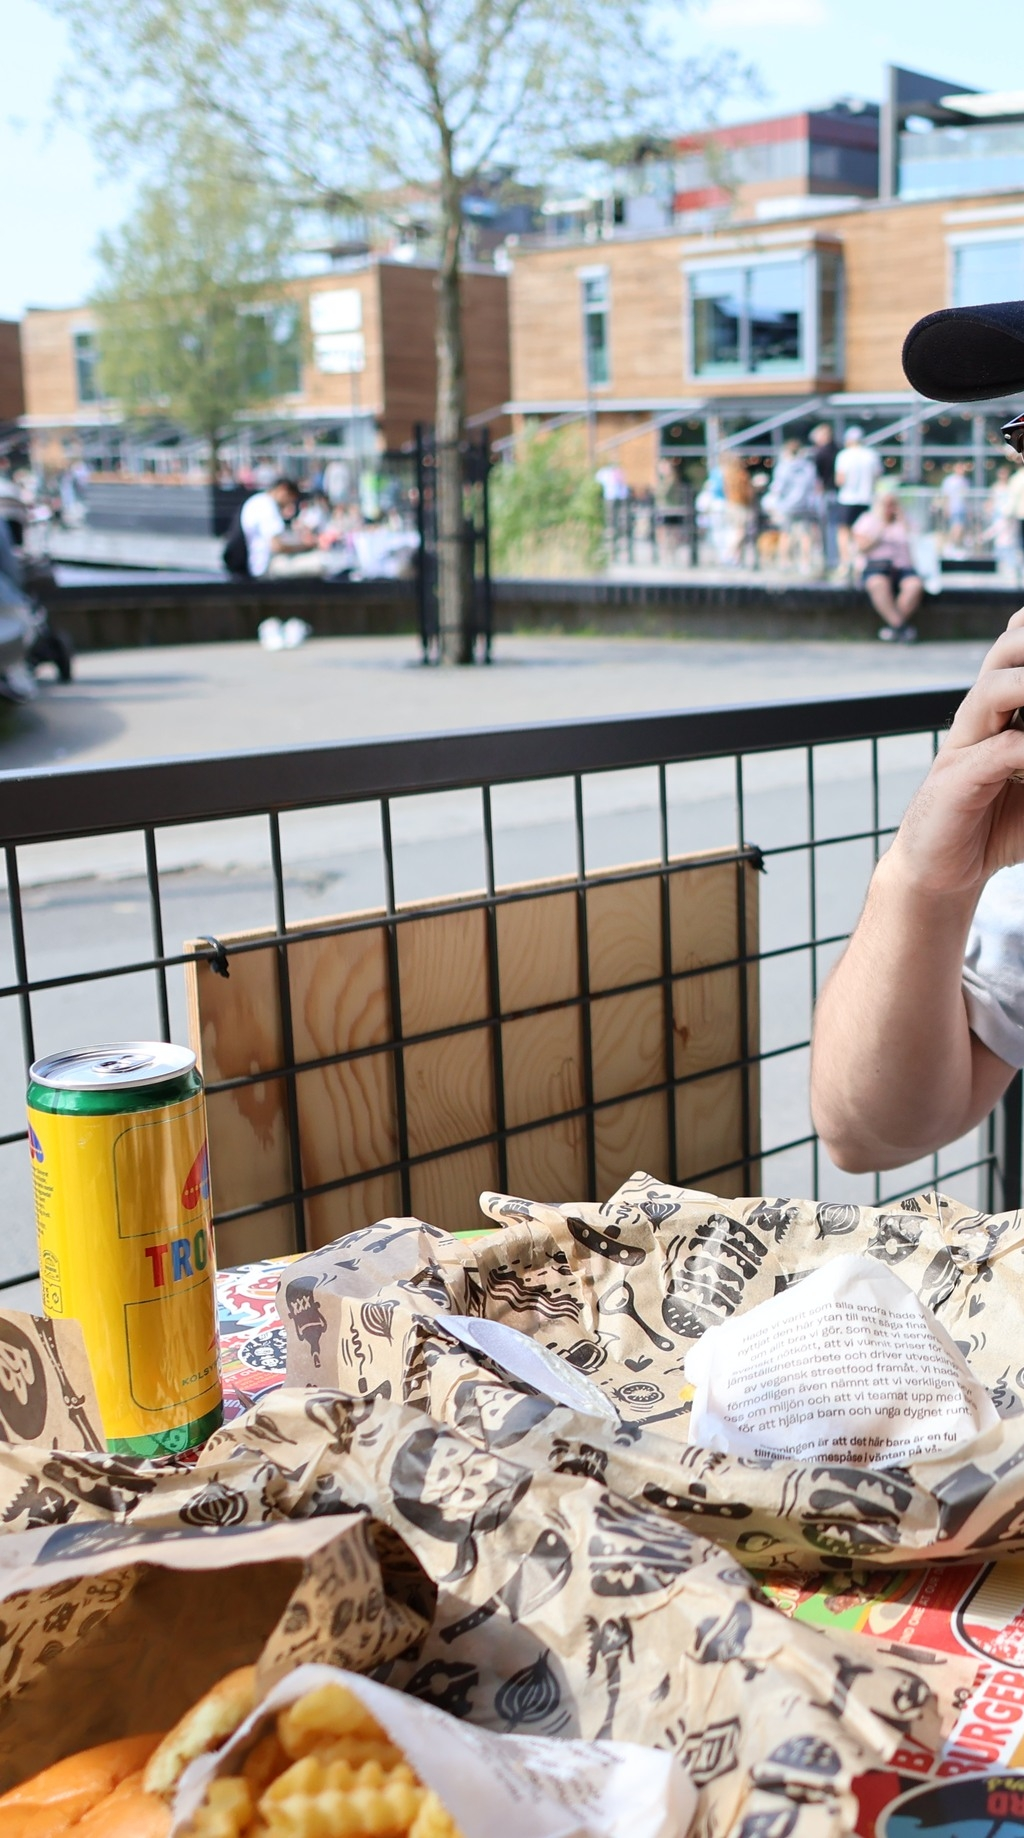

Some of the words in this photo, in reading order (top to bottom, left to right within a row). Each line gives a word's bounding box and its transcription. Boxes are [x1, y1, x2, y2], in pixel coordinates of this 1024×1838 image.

[145, 1230, 214, 1288] TRO
[771, 1321, 779, 1330] vi
[783, 1311, 806, 1325] varit
[809, 1302, 832, 1315] som
[835, 1302, 854, 1310] alla
[857, 1304, 887, 1316] andra
[889, 1310, 916, 1320] hade
[773, 1328, 793, 1340] den
[817, 1313, 842, 1325] ytan
[845, 1313, 858, 1321] till
[861, 1315, 877, 1324] att
[879, 1319, 903, 1330] säga
[906, 1321, 927, 1329] fina
[750, 1350, 767, 1362] om
[788, 1335, 806, 1345] bra
[809, 1328, 818, 1338] vi
[821, 1326, 842, 1338] gör.
[846, 1326, 871, 1335] Som
[873, 1329, 888, 1338] att
[824, 1340, 840, 1349] att
[844, 1339, 854, 1347] vi
[857, 1339, 891, 1348] vunnit
[894, 1341, 925, 1350] priser
[844, 1351, 867, 1360] och
[870, 1349, 902, 1360] driver
[744, 1384, 757, 1394] av
[760, 1370, 808, 1388] vegansk
[811, 1363, 873, 1377] streetfood
[876, 1362, 918, 1373] framåt.
[920, 1365, 931, 1374] Vi
[934, 1366, 960, 1378] hade
[723, 1413, 744, 1423] oss
[747, 1407, 766, 1419] om
[769, 1399, 804, 1414] miljön
[807, 1394, 831, 1406] och
[834, 1393, 851, 1403] att
[854, 1391, 864, 1399] vi
[867, 1391, 908, 1400] teamat
[911, 1392, 933, 1403] upp
[936, 1392, 962, 1402] med
[727, 1387, 795, 1412] förmodligen
[799, 1381, 827, 1393] även
[831, 1378, 869, 1389] nämnt
[872, 1378, 889, 1387] att
[893, 1377, 902, 1385] vi
[904, 1377, 955, 1389] verkligen
[738, 1422, 755, 1433] för
[758, 1420, 776, 1432] att
[778, 1412, 814, 1429] hjälpa
[817, 1408, 846, 1419] barn
[849, 1405, 872, 1416] och
[874, 1407, 901, 1419] unga
[903, 1405, 942, 1420] dygnet
[946, 1406, 973, 1417] runt.
[817, 1436, 829, 1446] är
[832, 1436, 848, 1445] att
[850, 1435, 867, 1446] det
[868, 1436, 885, 1447] här
[886, 1436, 911, 1448] bara
[914, 1434, 923, 1443] är
[927, 1433, 941, 1441] en
[943, 1431, 957, 1441] ful
[869, 1450, 906, 1463] väntan
[908, 1444, 923, 1459] på
